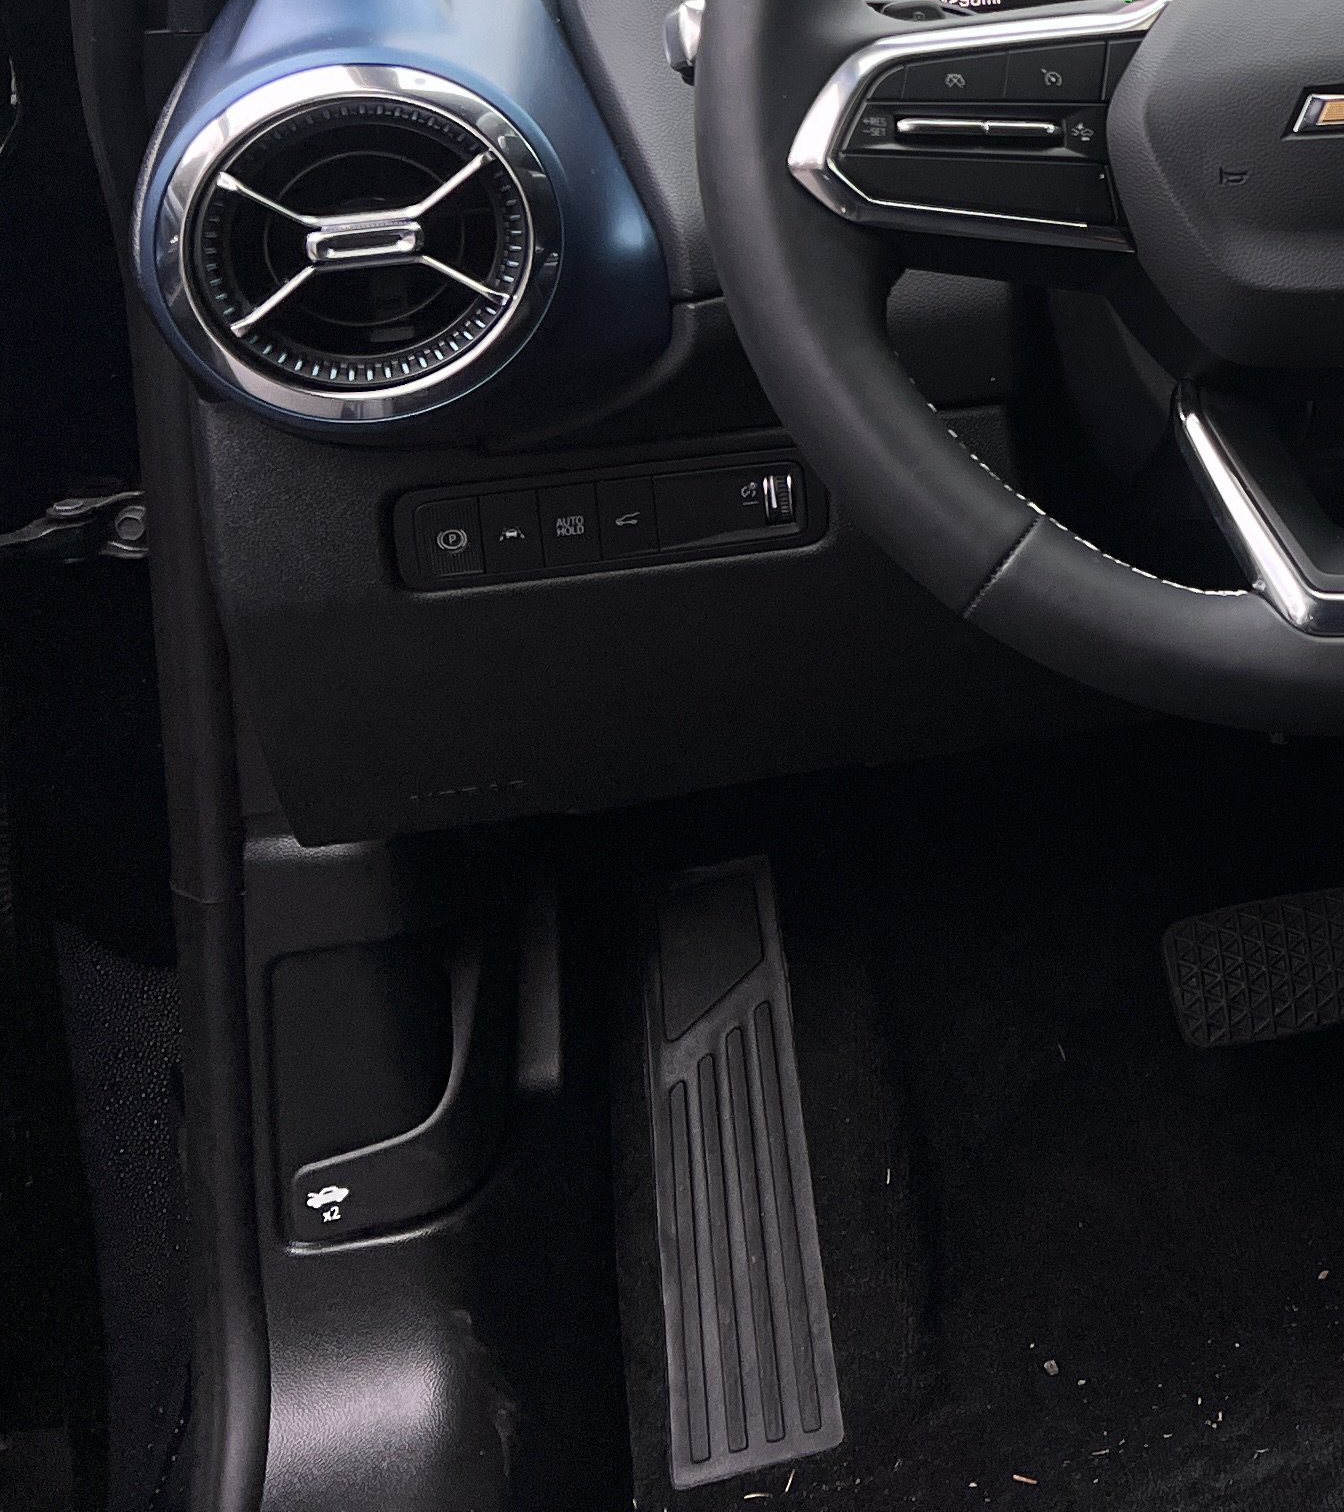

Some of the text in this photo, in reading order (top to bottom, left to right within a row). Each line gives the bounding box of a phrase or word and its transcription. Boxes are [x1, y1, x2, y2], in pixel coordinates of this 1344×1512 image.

[556, 515, 584, 527] AUTO
[556, 525, 585, 537] HOLD
[322, 1205, 341, 1223] x2
